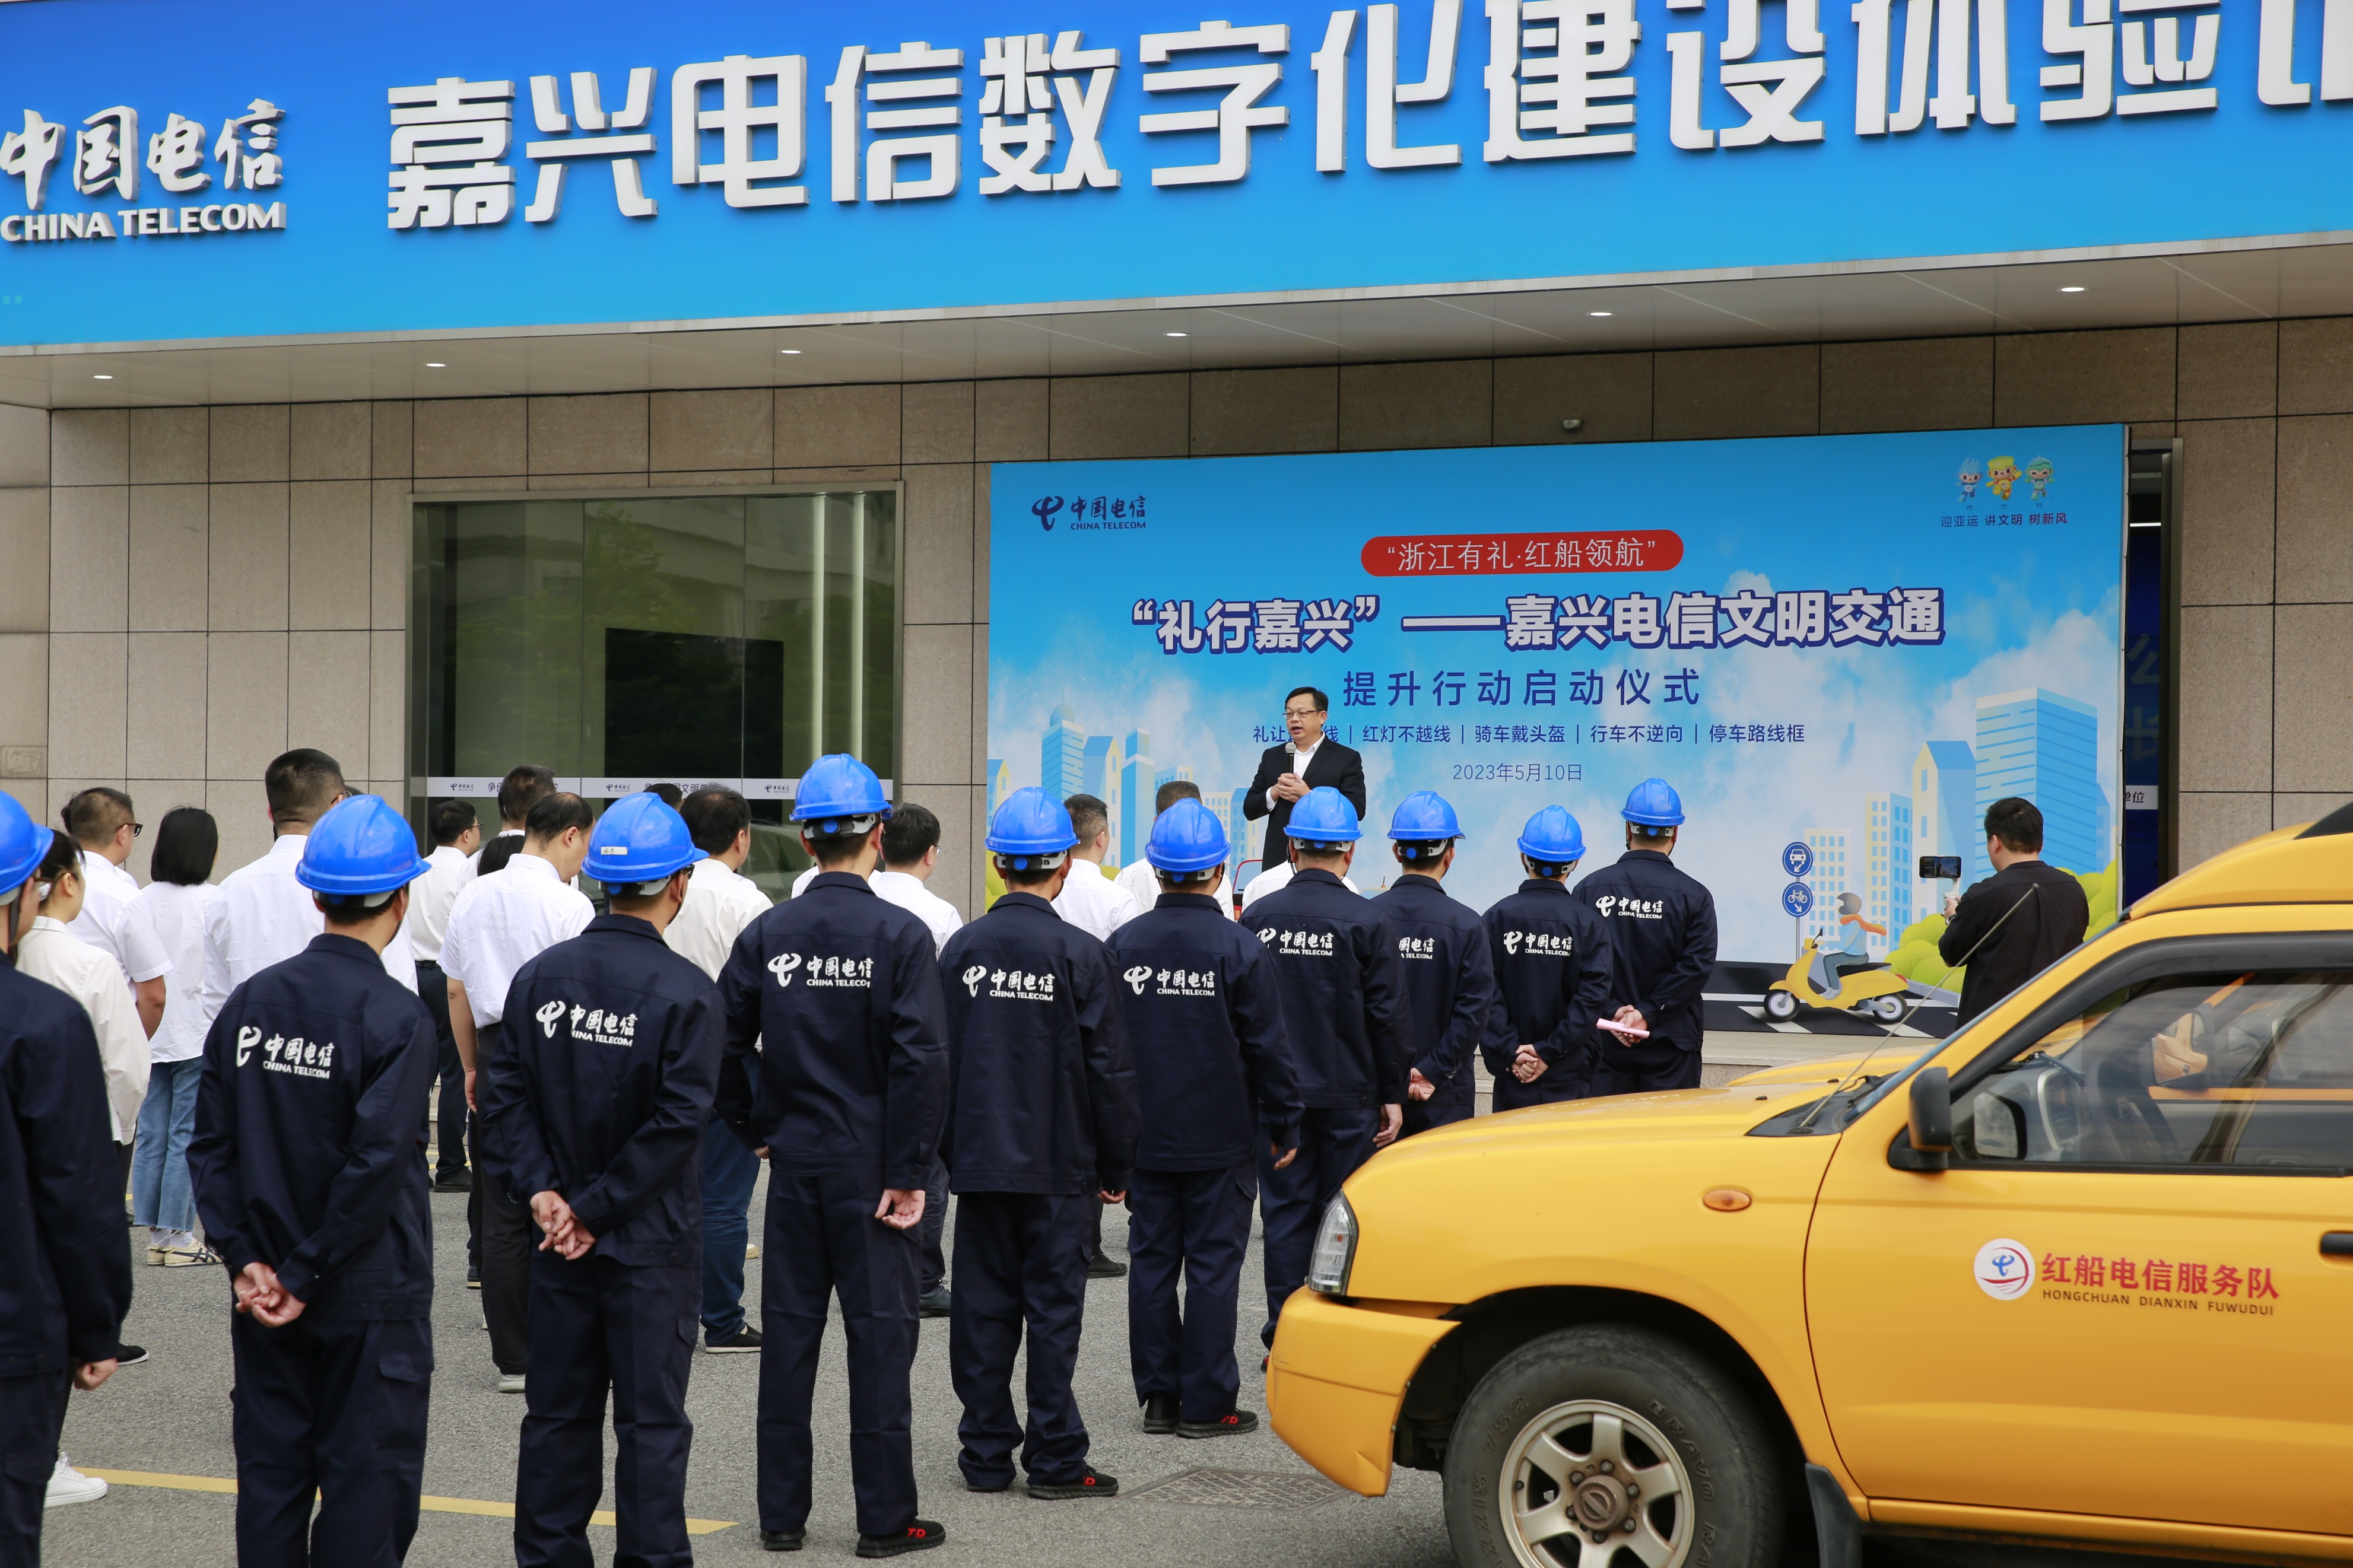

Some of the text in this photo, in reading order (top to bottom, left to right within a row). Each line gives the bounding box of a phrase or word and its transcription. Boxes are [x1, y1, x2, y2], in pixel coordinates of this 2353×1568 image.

[388, 0, 2353, 230] 嘉兴电信数字化建设体验
[0, 98, 285, 211] 中国电信
[0, 202, 286, 242] CHINA TELECOM
[1070, 495, 1147, 522] 中国电信
[1070, 520, 1147, 530] CHINA TELECOM
[1941, 513, 2068, 527] 迎亚运 讲文明 树新风
[1387, 536, 1656, 572] “浙江有礼·红船领航”
[1343, 667, 1700, 707] 提升行动启动仪式
[1253, 723, 1805, 743] 礼让线 红灯不越线 骑车戴头盔 行车不逆向 停车路线框
[1453, 762, 1582, 782] 2023年5月10日
[1618, 896, 1663, 914] 中国电信
[1279, 930, 1334, 949] 中国电信
[1399, 937, 1435, 953] 国电信
[1525, 932, 1573, 950] 中国电信
[806, 955, 874, 979] 中国电信
[806, 978, 833, 987] CHINA
[990, 968, 1055, 993] 中国电信
[1157, 968, 1215, 988] 中国电信
[989, 990, 1053, 1001] CHINA TELECOM
[1181, 988, 1215, 997] TELECOM
[570, 1004, 638, 1037] 中国电信
[570, 1029, 633, 1047] HINA TELECOM
[265, 1033, 335, 1068] 中国电信
[263, 1060, 331, 1080] CHINA TELECOM
[2041, 1252, 2280, 1300] 红船电信服务队
[2043, 1289, 2274, 1316] HONGCHUAN DIANXIN FUWUDUI
